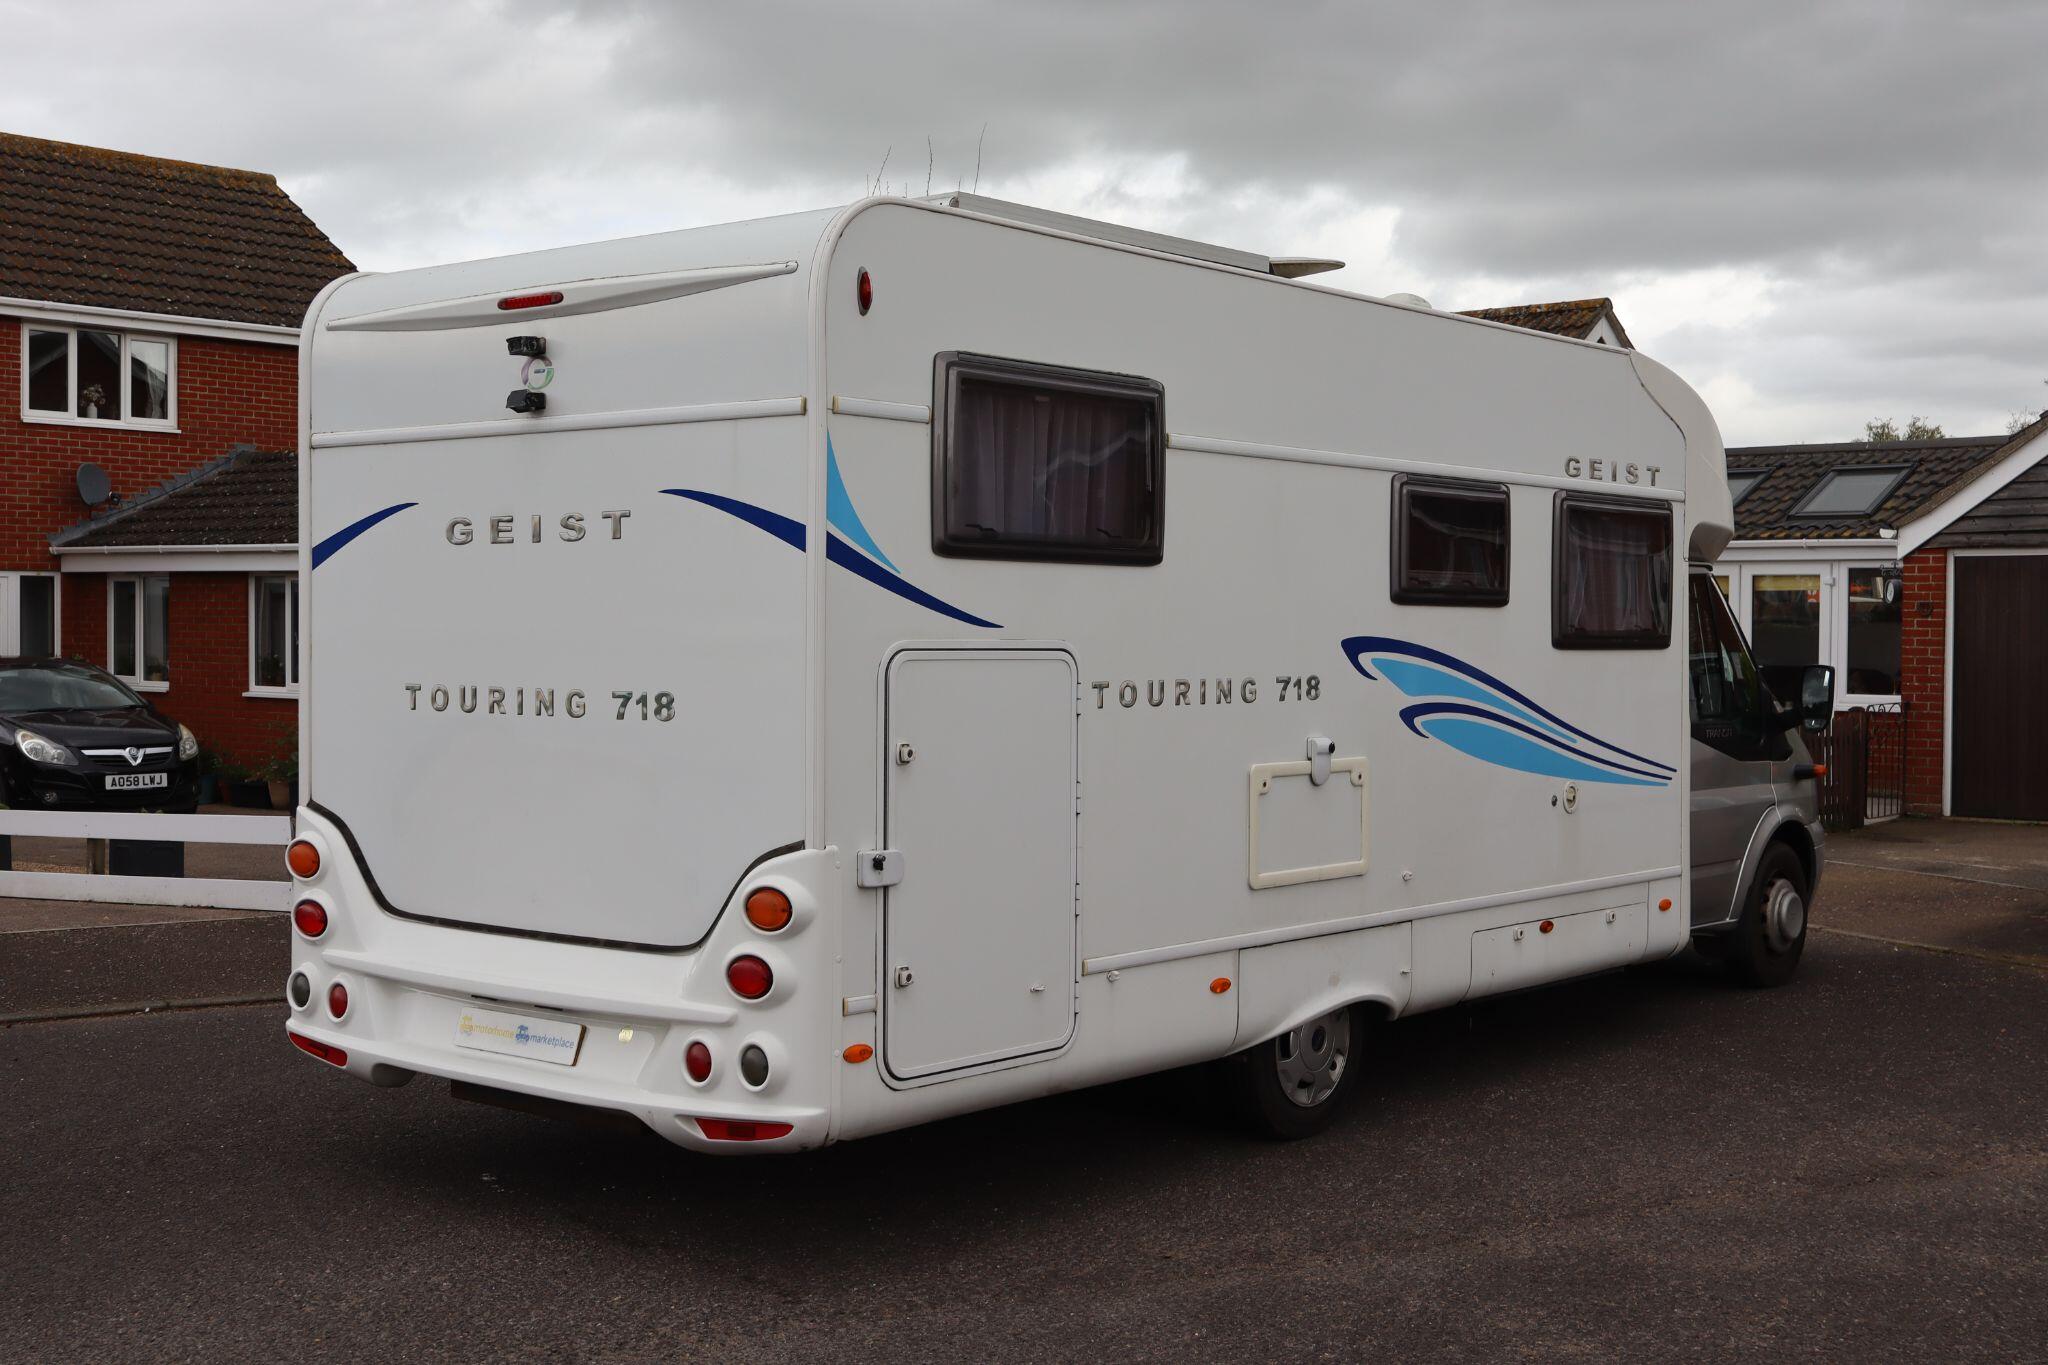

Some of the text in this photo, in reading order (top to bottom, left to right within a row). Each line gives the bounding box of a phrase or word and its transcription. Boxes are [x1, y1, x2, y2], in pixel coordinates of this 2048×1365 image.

[1565, 457, 1660, 486] GEIST
[445, 510, 631, 545] GEIST
[405, 683, 676, 722] TOURING 718
[1092, 675, 1321, 709] TOURING 718
[142, 774, 163, 786] LWJ
[530, 1034, 575, 1049] marketplace
